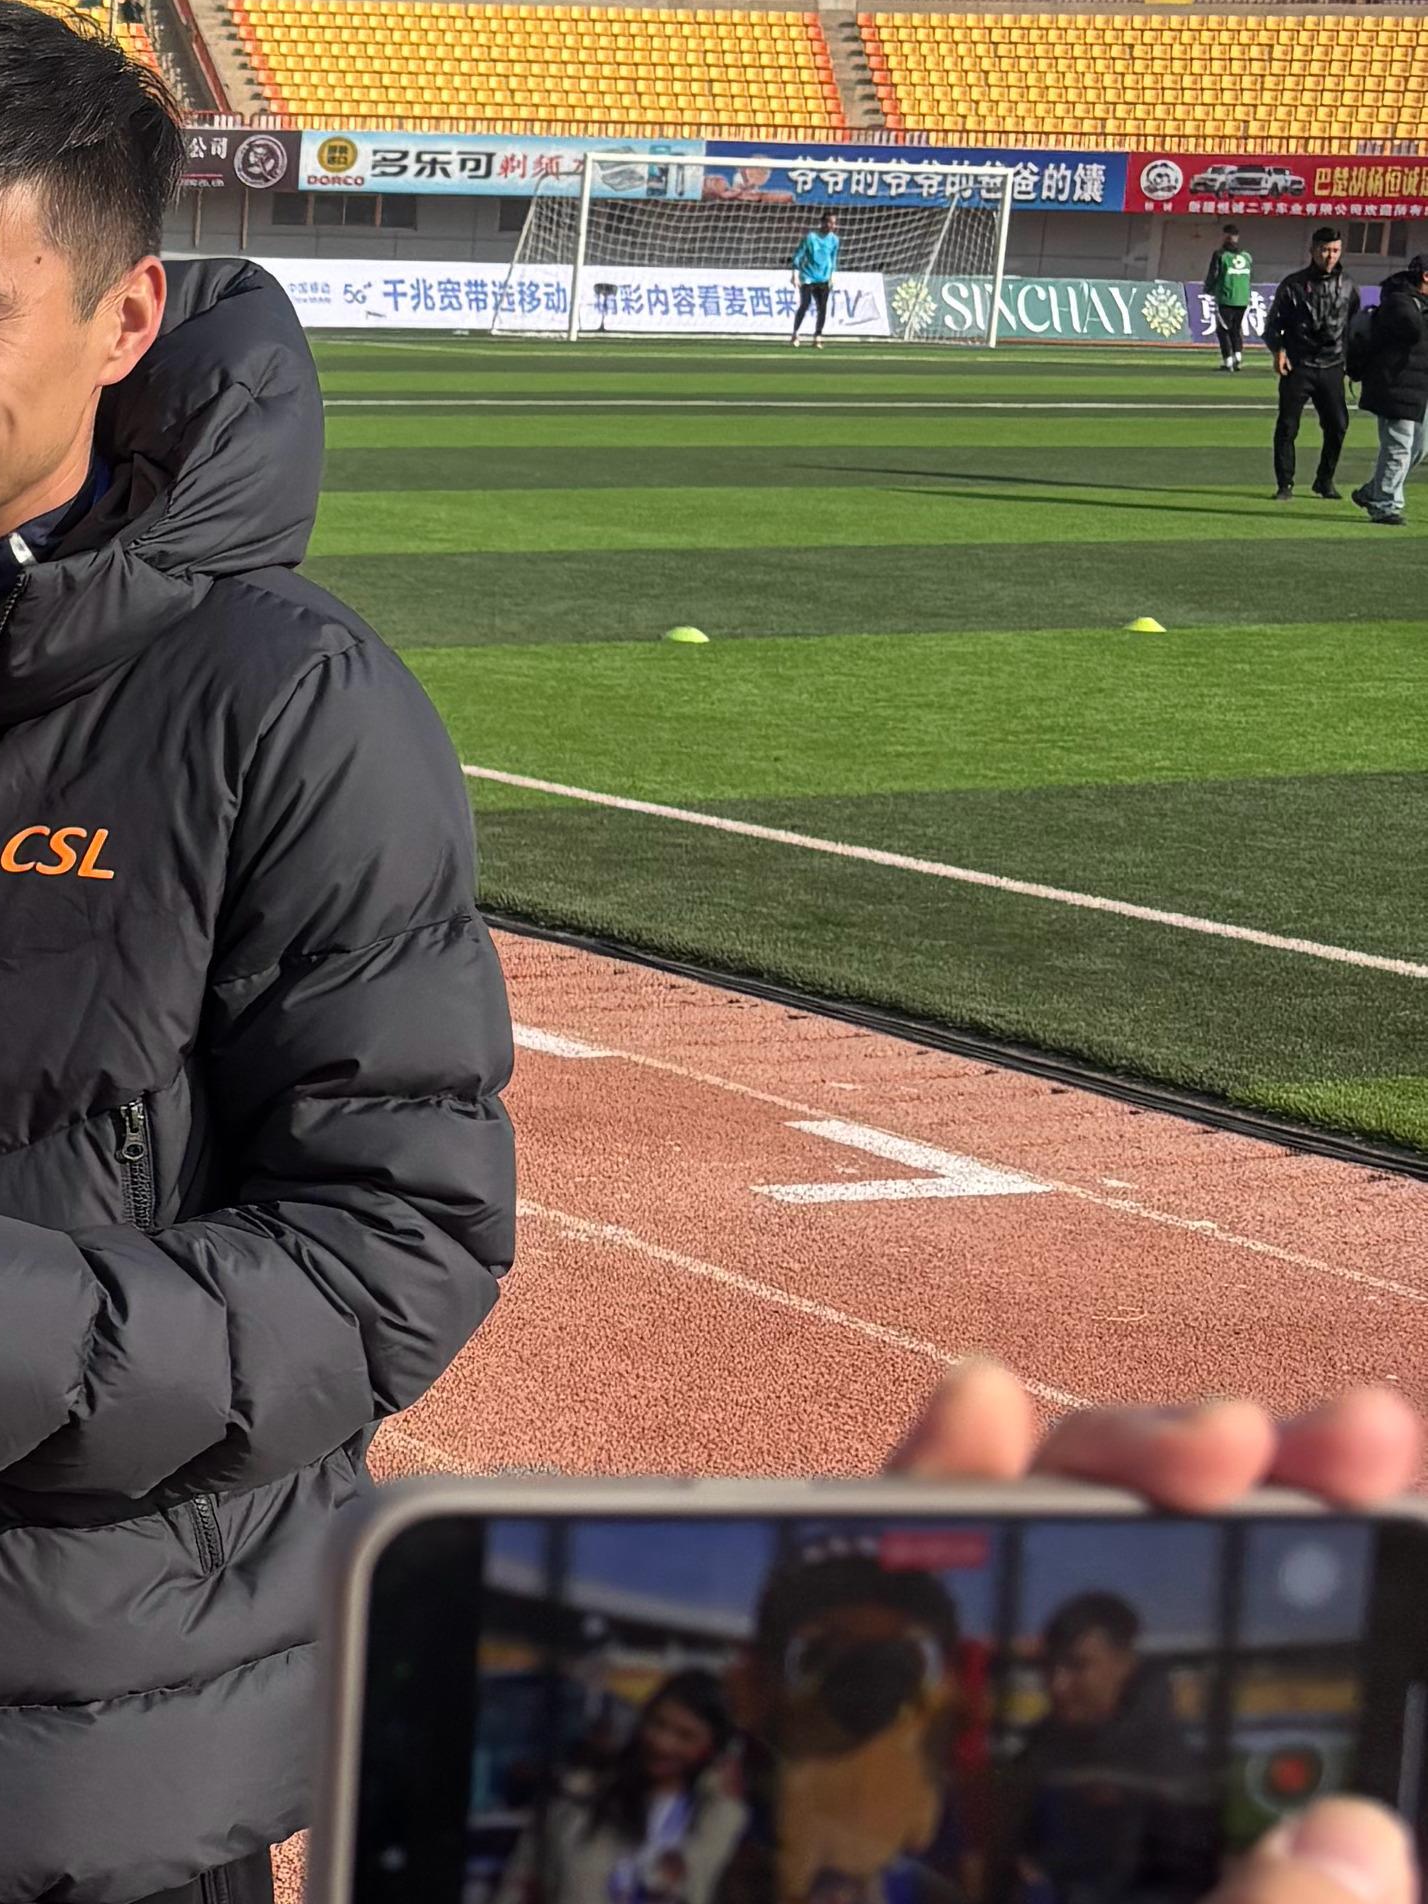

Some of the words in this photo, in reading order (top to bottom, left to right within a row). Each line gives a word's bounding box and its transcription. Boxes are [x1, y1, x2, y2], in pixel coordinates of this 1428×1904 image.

[189, 136, 228, 159] 公司
[307, 175, 365, 187] DORCO
[940, 278, 1138, 336] SINCHAY
[0, 825, 115, 879] CSL
